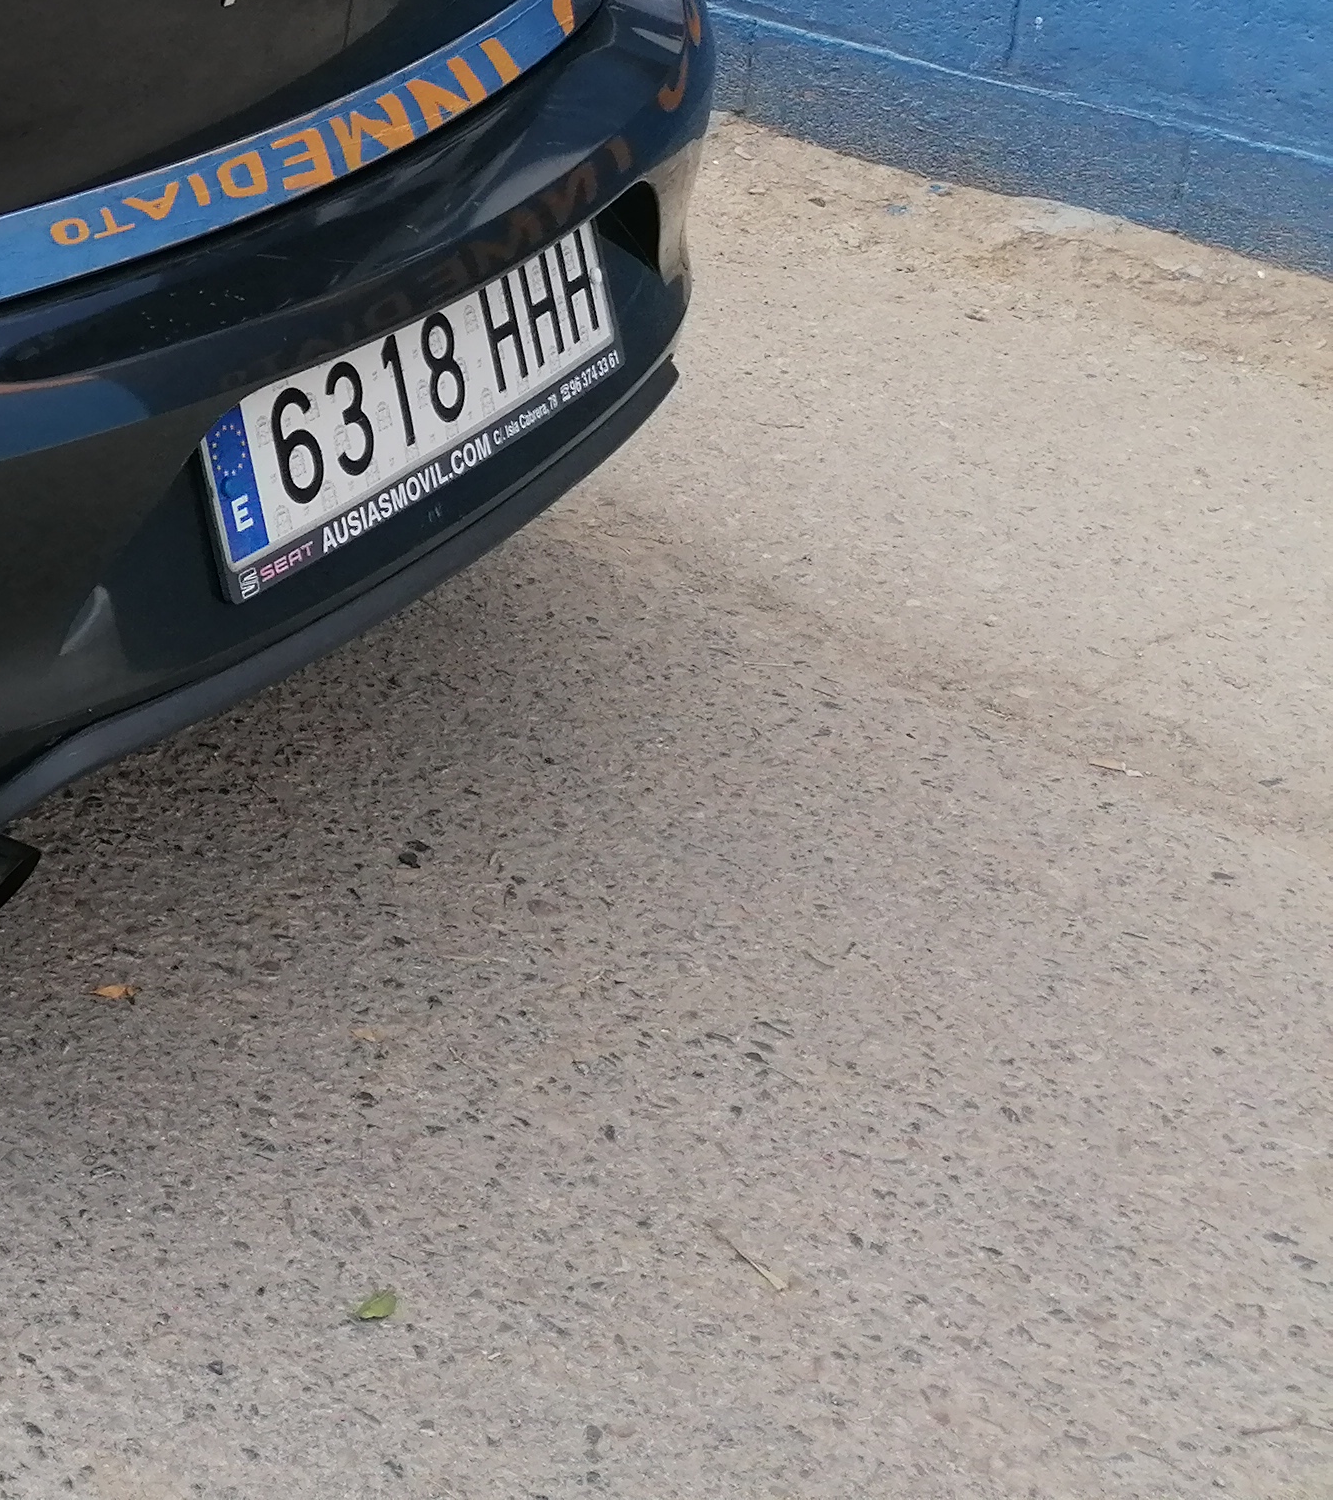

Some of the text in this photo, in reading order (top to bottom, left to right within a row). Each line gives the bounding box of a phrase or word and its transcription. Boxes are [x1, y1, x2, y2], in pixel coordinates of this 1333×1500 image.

[230, 227, 600, 533] E 6318 HHH
[259, 540, 314, 583] SEAT
[321, 432, 492, 555] AUSIASMOVIL.COM
